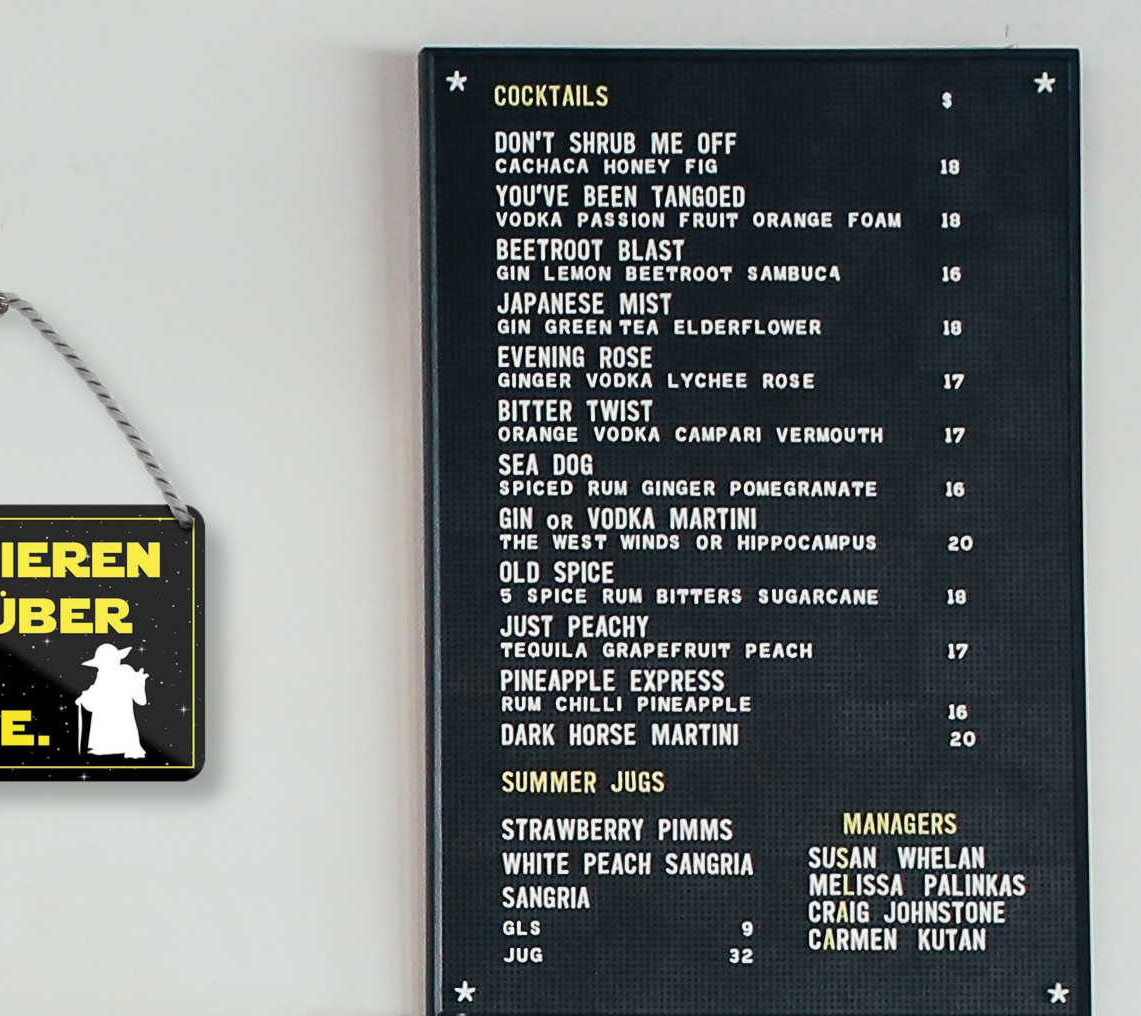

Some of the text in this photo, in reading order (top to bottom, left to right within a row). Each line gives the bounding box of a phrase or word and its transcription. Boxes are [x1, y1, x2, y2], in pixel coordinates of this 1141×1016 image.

[494, 84, 953, 109] COCKTAILS $
[494, 130, 737, 155] DON'T SHRUB ME OFF
[495, 157, 960, 175] CACHACA HONEY FIG 18
[495, 184, 746, 209] YOU'VE BEEN TANGOED
[495, 211, 961, 229] VODKA PASSION FRUIT ORANGE FOAM 18
[496, 238, 685, 262] BEETROOT BLAST
[496, 265, 530, 282] GIN
[544, 265, 612, 282] LEMON
[625, 265, 733, 282] BEETROOT
[941, 266, 962, 283] 16
[496, 291, 672, 316] JAPANESE MIST
[497, 318, 962, 336] GIN GREEN TEA ELDERFLOWER 18
[497, 345, 653, 370] EVENING ROSE
[497, 372, 965, 390] GINGER VODKA LYCHEE ROSE 17
[498, 399, 654, 423] BITTER TWIST
[497, 426, 966, 444] ORANGE VODKA CAMPARI VERMOUTH 17
[498, 453, 594, 476] SEA DOG
[499, 480, 965, 498] SPICED RUM GINGER POMEGRANATE 16
[499, 507, 757, 531] GIN OR VODKA MARTINI
[499, 533, 974, 552] THE WEST WINDS OR HIPPOCAMPUS 20
[499, 560, 615, 584] OLD SPICE
[499, 587, 967, 606] 5 SPICE RUM BITTERS SUGARCANE 18
[499, 615, 649, 638] JUST PEACHY
[500, 642, 969, 660] TEQUILA GRAPEFRUIT PEACH 17
[500, 669, 725, 693] PINEAPPLE EXPRESS
[501, 696, 968, 721] RUM CHILLI PINEAPPLE 16
[501, 723, 977, 748] DARK HORSE MARTINI 20
[501, 770, 665, 794] SUMMER JUGS
[501, 818, 734, 842] STRAWBERRY PIMMS
[843, 812, 958, 836] MANAGERS
[502, 853, 754, 876] WHITE PEACH SANGRIA
[808, 846, 985, 870] SUSAN WHELAN
[809, 873, 1027, 898] MELISSA PALINKAS
[502, 886, 591, 910] SANGRIA
[808, 901, 1006, 924] CRAIG JOHNSTONE
[502, 920, 754, 937] GLS 9
[808, 928, 987, 952] CARMEN KUTAN
[503, 947, 754, 964] JUG 32
